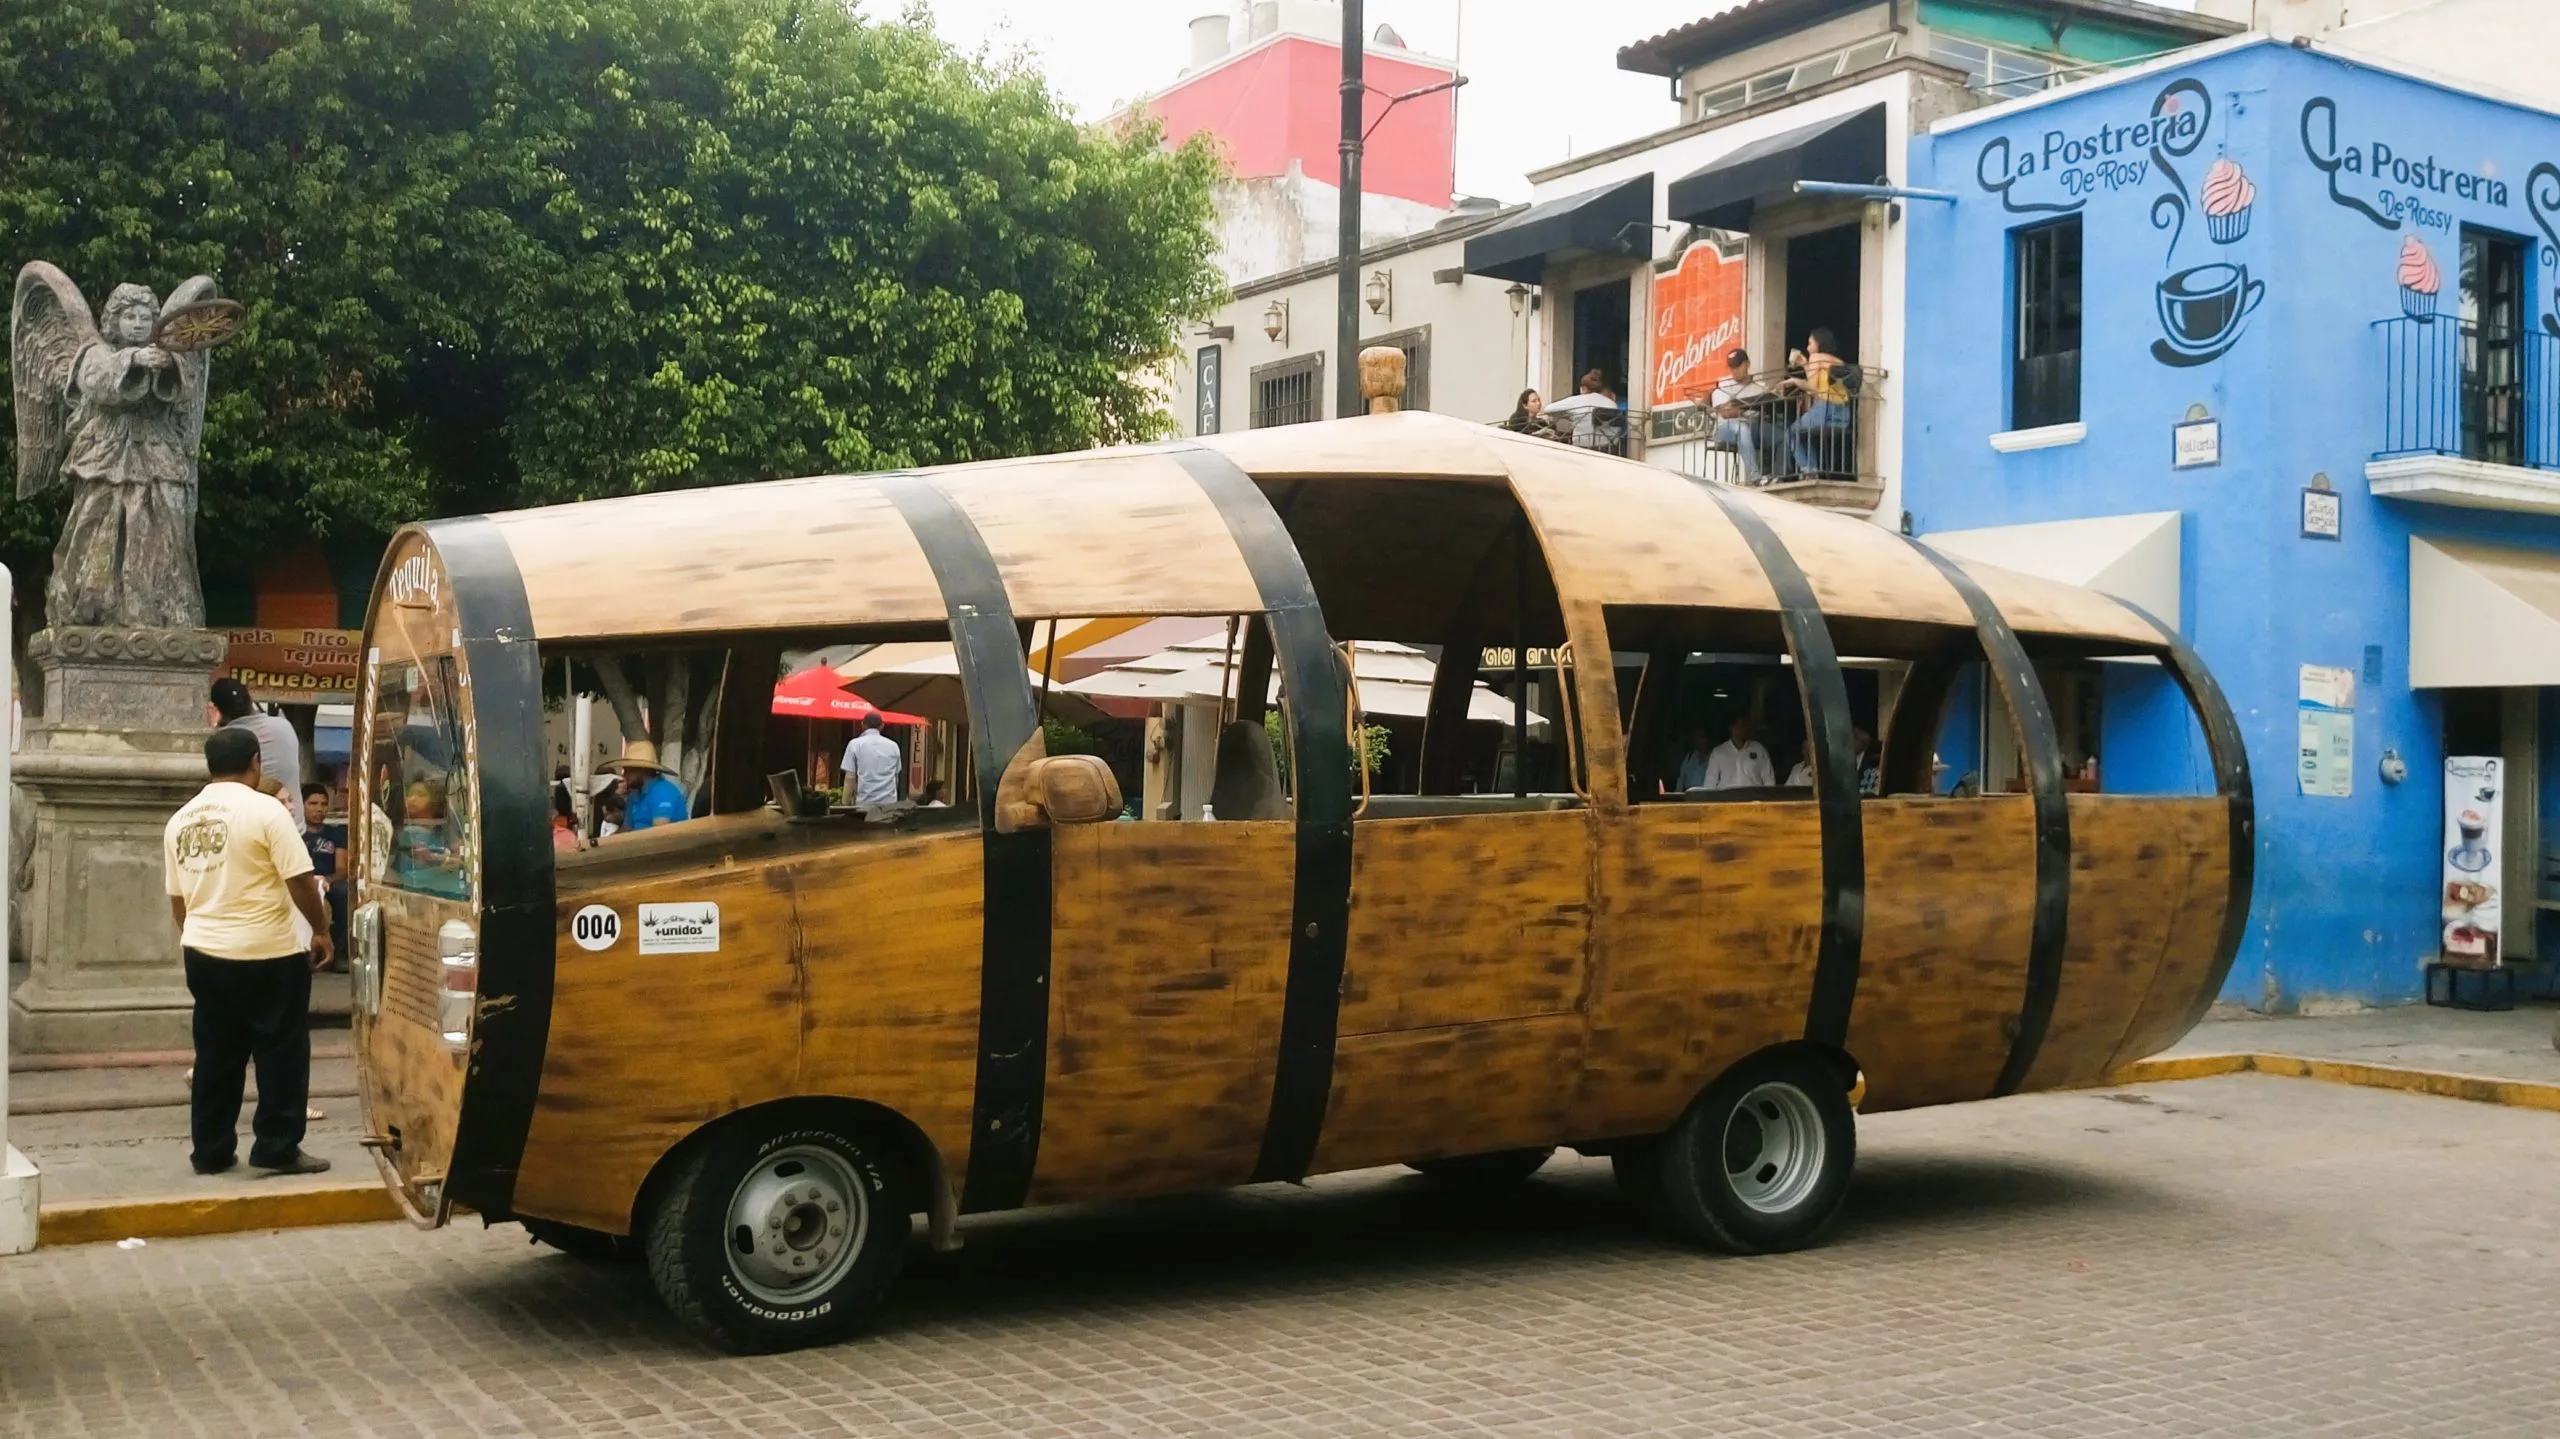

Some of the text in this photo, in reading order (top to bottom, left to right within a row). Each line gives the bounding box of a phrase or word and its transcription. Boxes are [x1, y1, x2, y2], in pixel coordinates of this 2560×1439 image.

[1977, 136, 2036, 212] La
[2060, 159, 2149, 196] De Rosy
[2378, 189, 2453, 235] De Rossy
[1655, 315, 1740, 399] Palomar
[303, 631, 349, 646] Rico
[577, 914, 616, 940] 004
[655, 925, 703, 936] +unidos
[758, 1130, 862, 1156] All-Terrain
[721, 1274, 832, 1321] BFGoodrich
